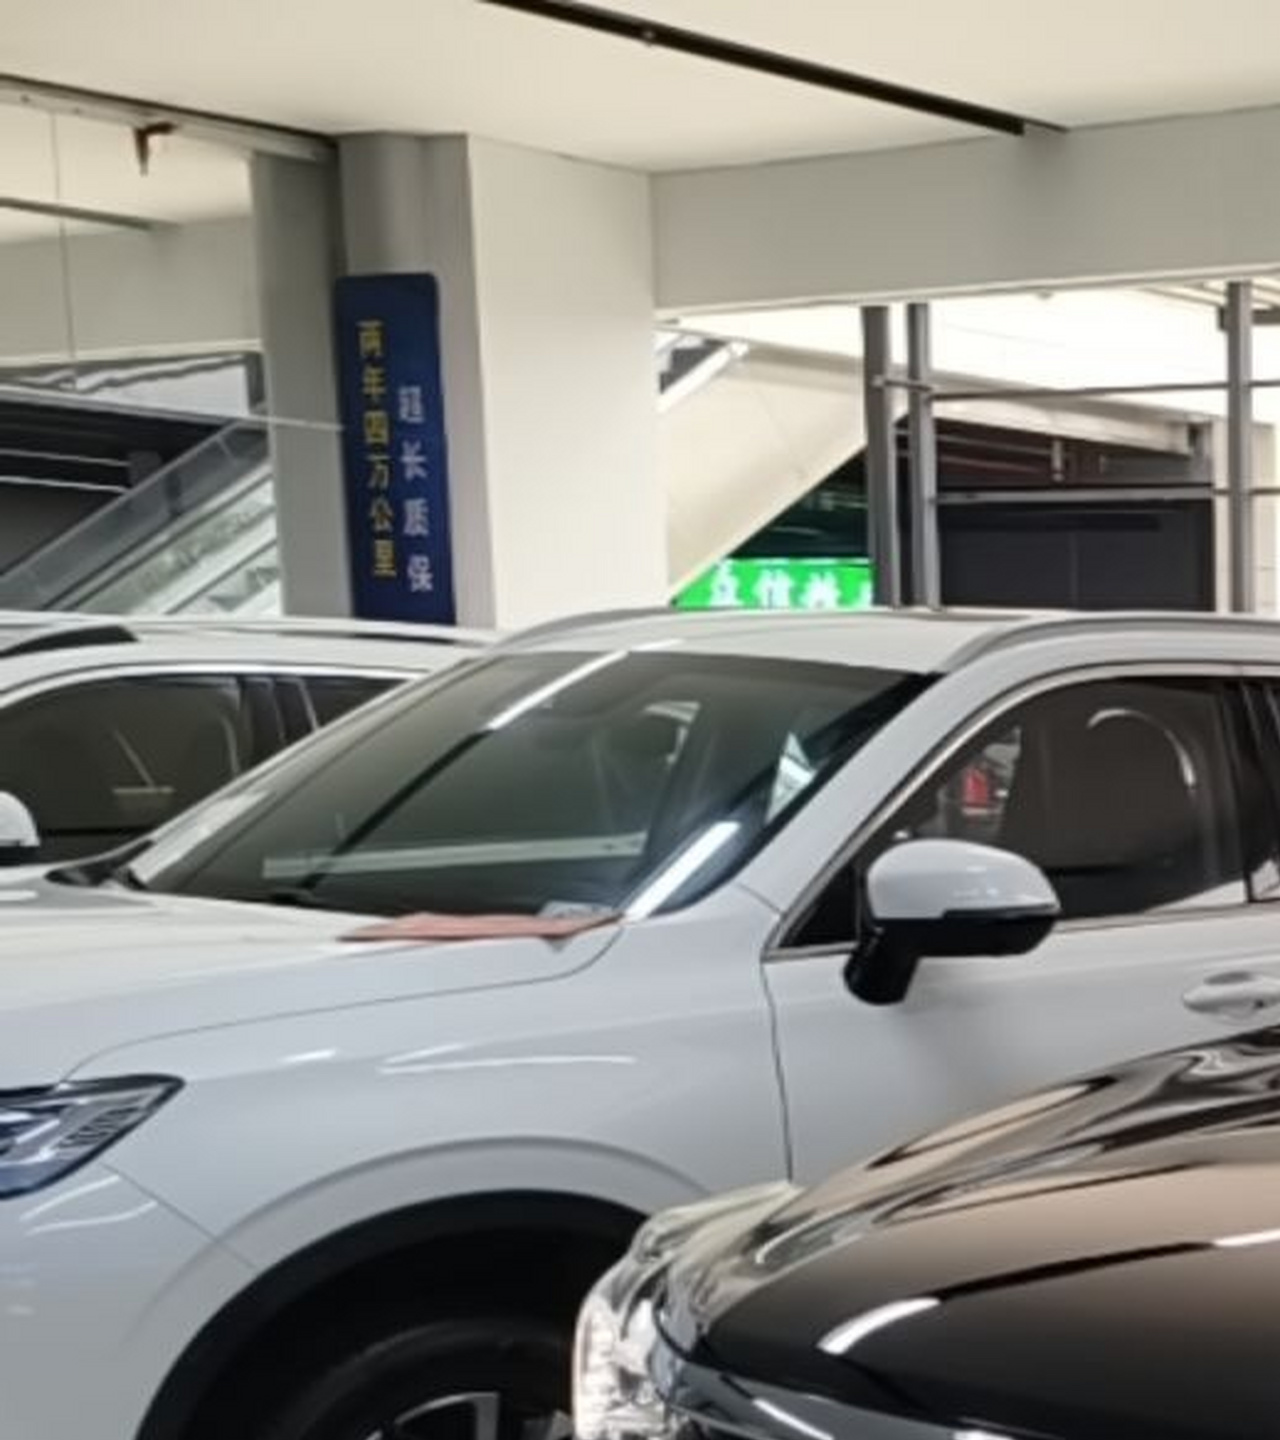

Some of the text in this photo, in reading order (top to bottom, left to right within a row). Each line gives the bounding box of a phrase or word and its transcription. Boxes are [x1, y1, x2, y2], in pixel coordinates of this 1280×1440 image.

[357, 320, 396, 577] 两年四万公里
[399, 386, 433, 592] 超长质保
